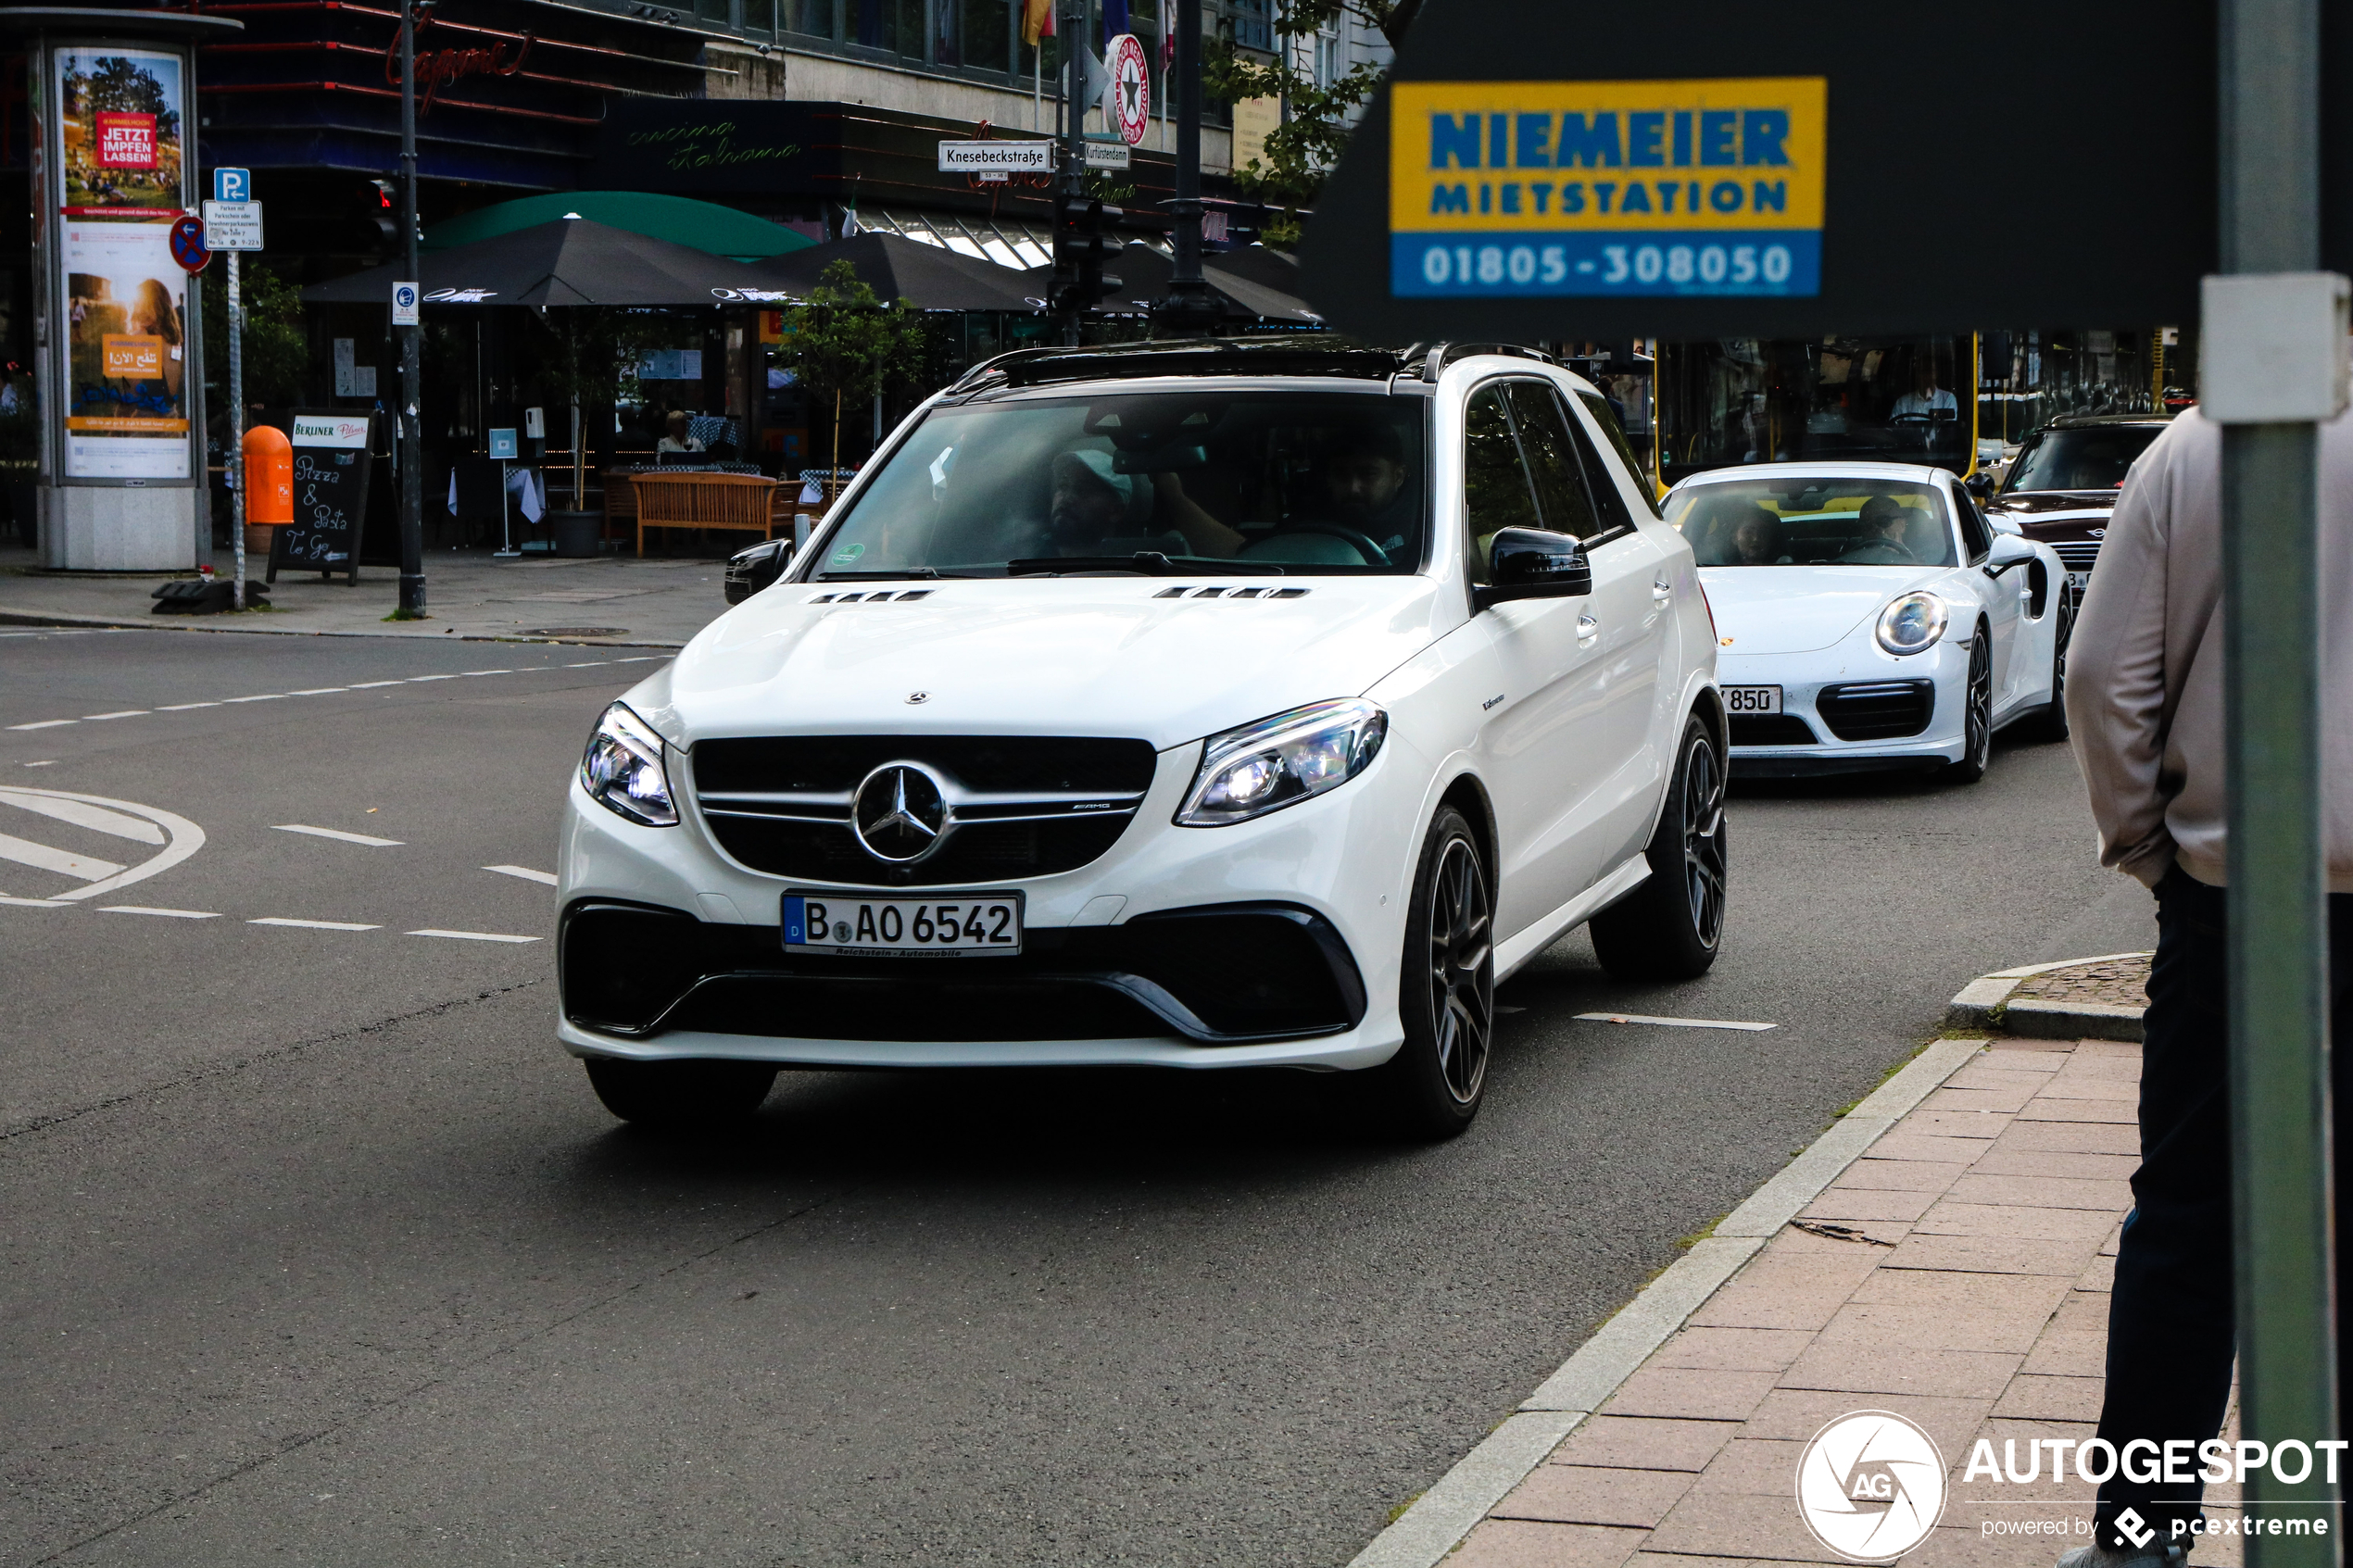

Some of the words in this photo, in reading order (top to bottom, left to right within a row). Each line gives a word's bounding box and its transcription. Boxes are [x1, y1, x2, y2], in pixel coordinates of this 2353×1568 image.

[1129, 42, 1144, 77] MEDIA
[1139, 81, 1148, 124] HOTEL
[103, 128, 150, 141] JETZT
[629, 121, 736, 145] cucina
[1124, 122, 1142, 142] BERLIN
[1429, 109, 1792, 169] NIEMEIER
[104, 142, 151, 152] IMPFEN
[104, 153, 151, 162] LASSEN!
[668, 137, 801, 170] italiana
[1086, 144, 1127, 160] Kurfürstendamm
[947, 150, 1043, 166] Knesebeckstraße
[1430, 181, 1788, 216] MIETSTATION
[295, 423, 333, 437] BERLINER
[295, 455, 340, 483] Pizza
[303, 483, 317, 506] &
[314, 504, 347, 530] Pasta
[286, 530, 305, 555] To
[309, 534, 330, 560] Go
[1730, 690, 1770, 710] 850
[791, 926, 799, 936] D
[806, 902, 829, 940] B
[856, 904, 902, 942] AO
[912, 905, 1012, 943] 6542
[836, 947, 891, 956] Reichstein
[899, 949, 962, 958] Automobile
